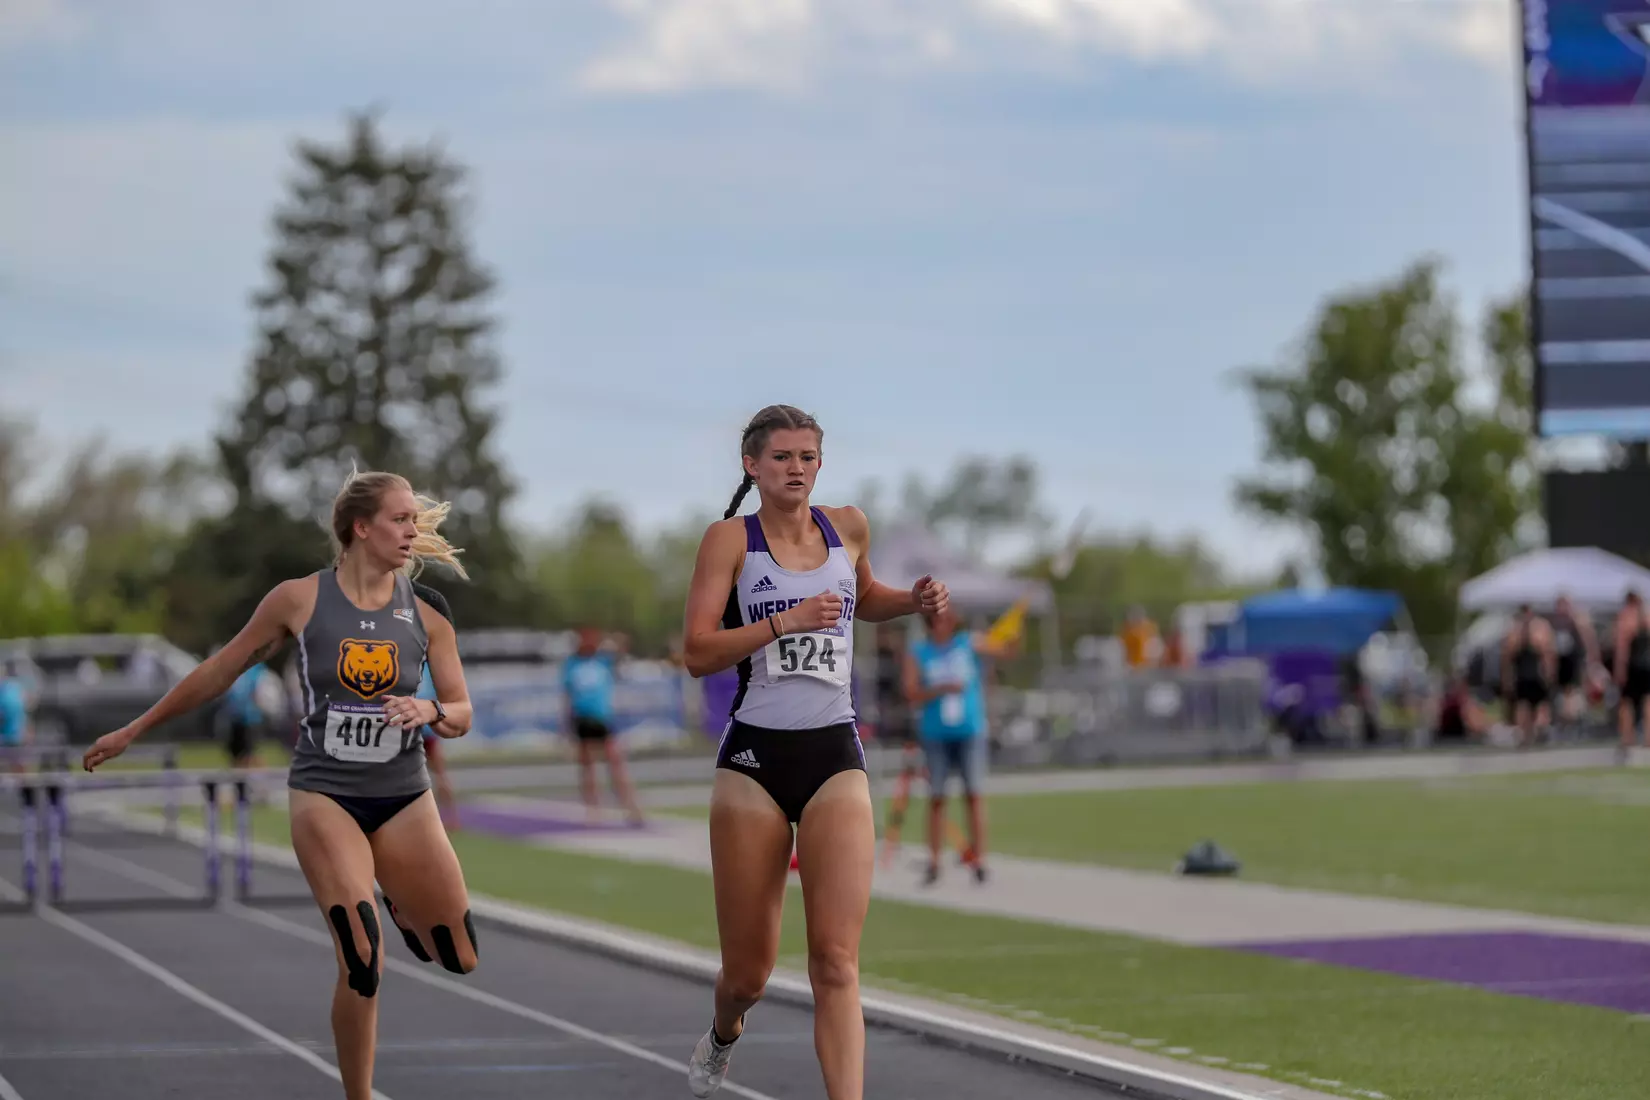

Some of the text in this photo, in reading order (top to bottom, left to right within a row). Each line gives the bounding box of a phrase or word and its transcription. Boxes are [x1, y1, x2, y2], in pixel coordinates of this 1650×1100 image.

[751, 585, 777, 594] adidas
[748, 597, 807, 623] WEBE
[778, 636, 836, 672] 524
[336, 716, 389, 748] 407
[730, 756, 760, 768] adidas
